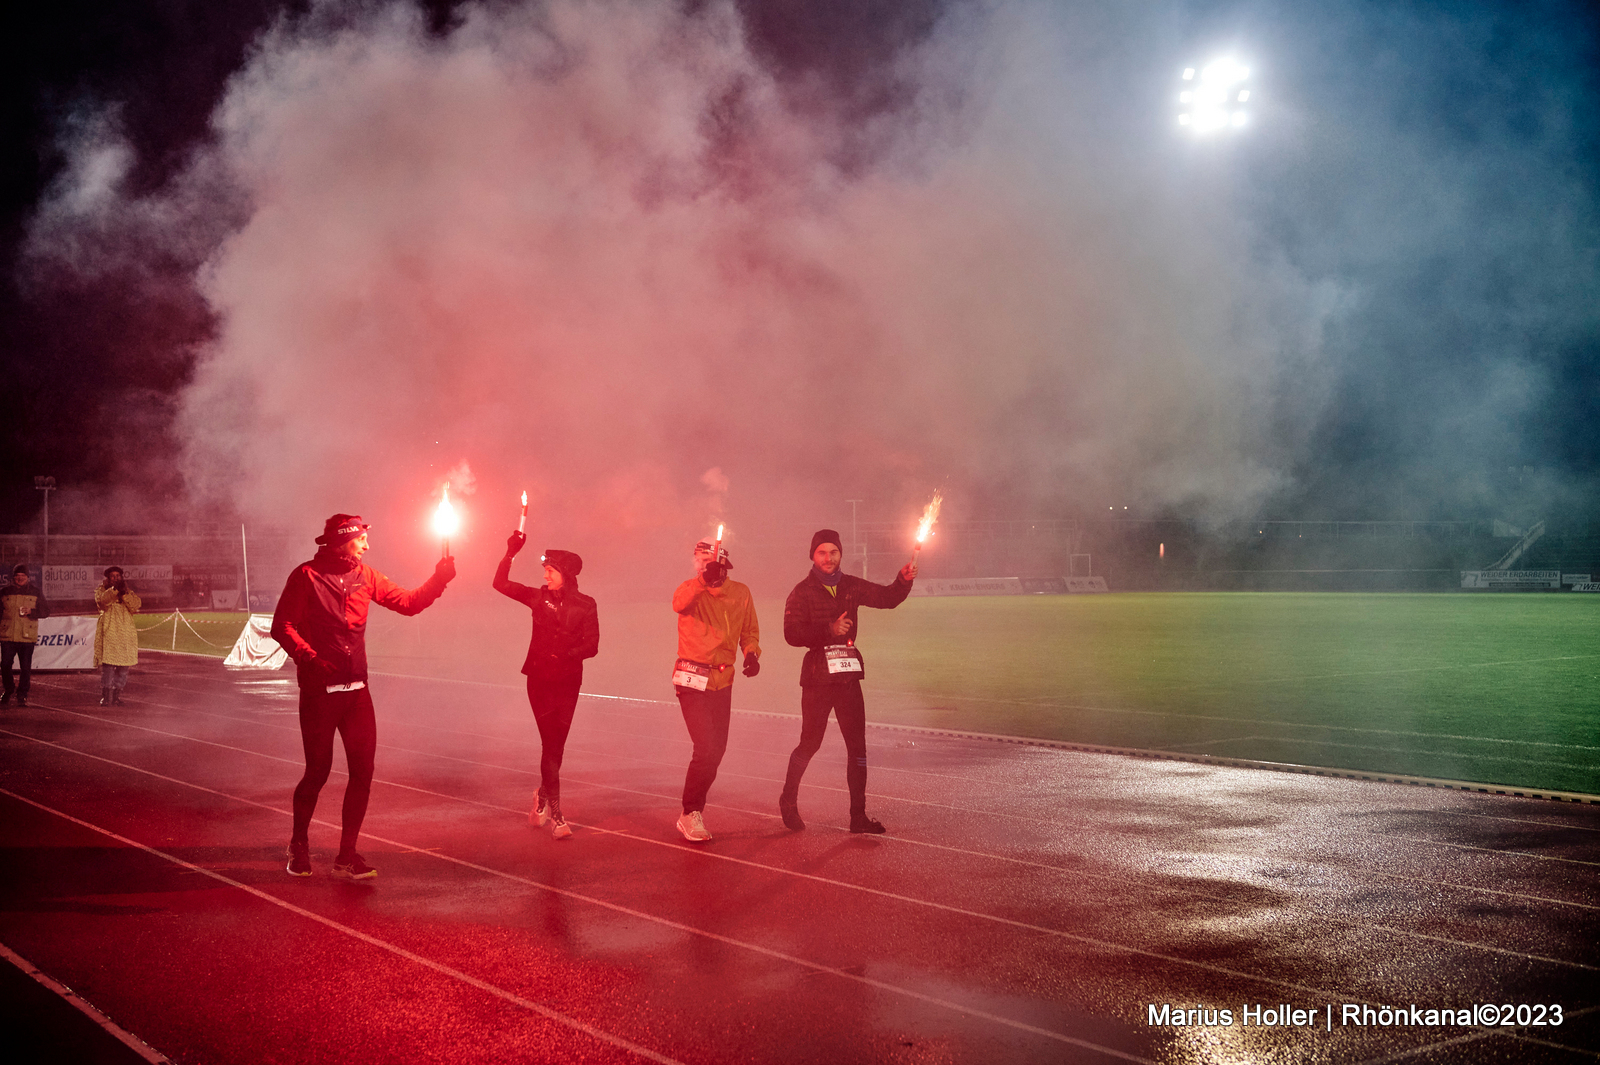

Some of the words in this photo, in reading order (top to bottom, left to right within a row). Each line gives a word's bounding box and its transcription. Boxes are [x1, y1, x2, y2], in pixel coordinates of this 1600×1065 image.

[337, 525, 360, 535] SILVA
[44, 567, 88, 581] aiutanda
[1583, 583, 1600, 591] WEI
[34, 634, 74, 647] ERZEN
[840, 661, 852, 669] 324
